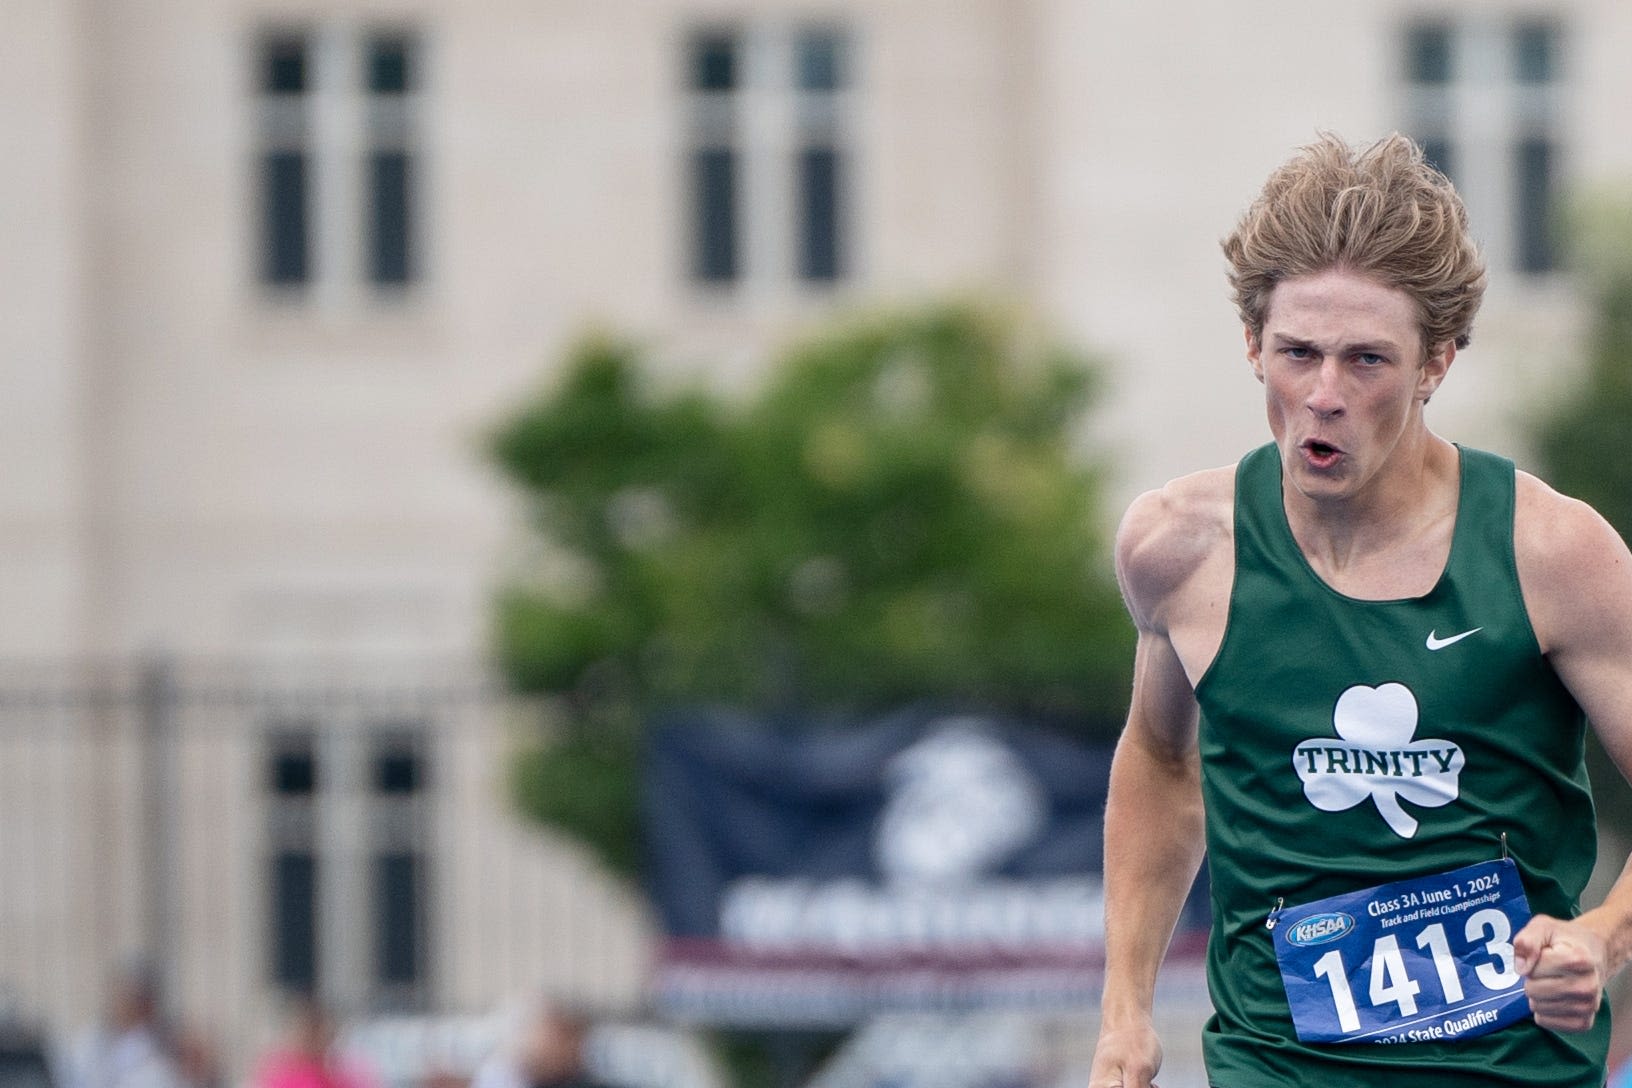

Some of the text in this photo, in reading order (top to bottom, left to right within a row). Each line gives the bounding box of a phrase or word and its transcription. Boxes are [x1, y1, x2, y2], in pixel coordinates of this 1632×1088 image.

[1297, 746, 1458, 777] TRINITY
[1367, 872, 1501, 917] Class 3A June 1, 2024
[1380, 890, 1501, 929] Track and Field Championships
[1296, 917, 1347, 943] KHSAA
[1312, 907, 1520, 1034] 1413
[1408, 1026, 1444, 1043] State
[1444, 1009, 1498, 1036] Qualifier
